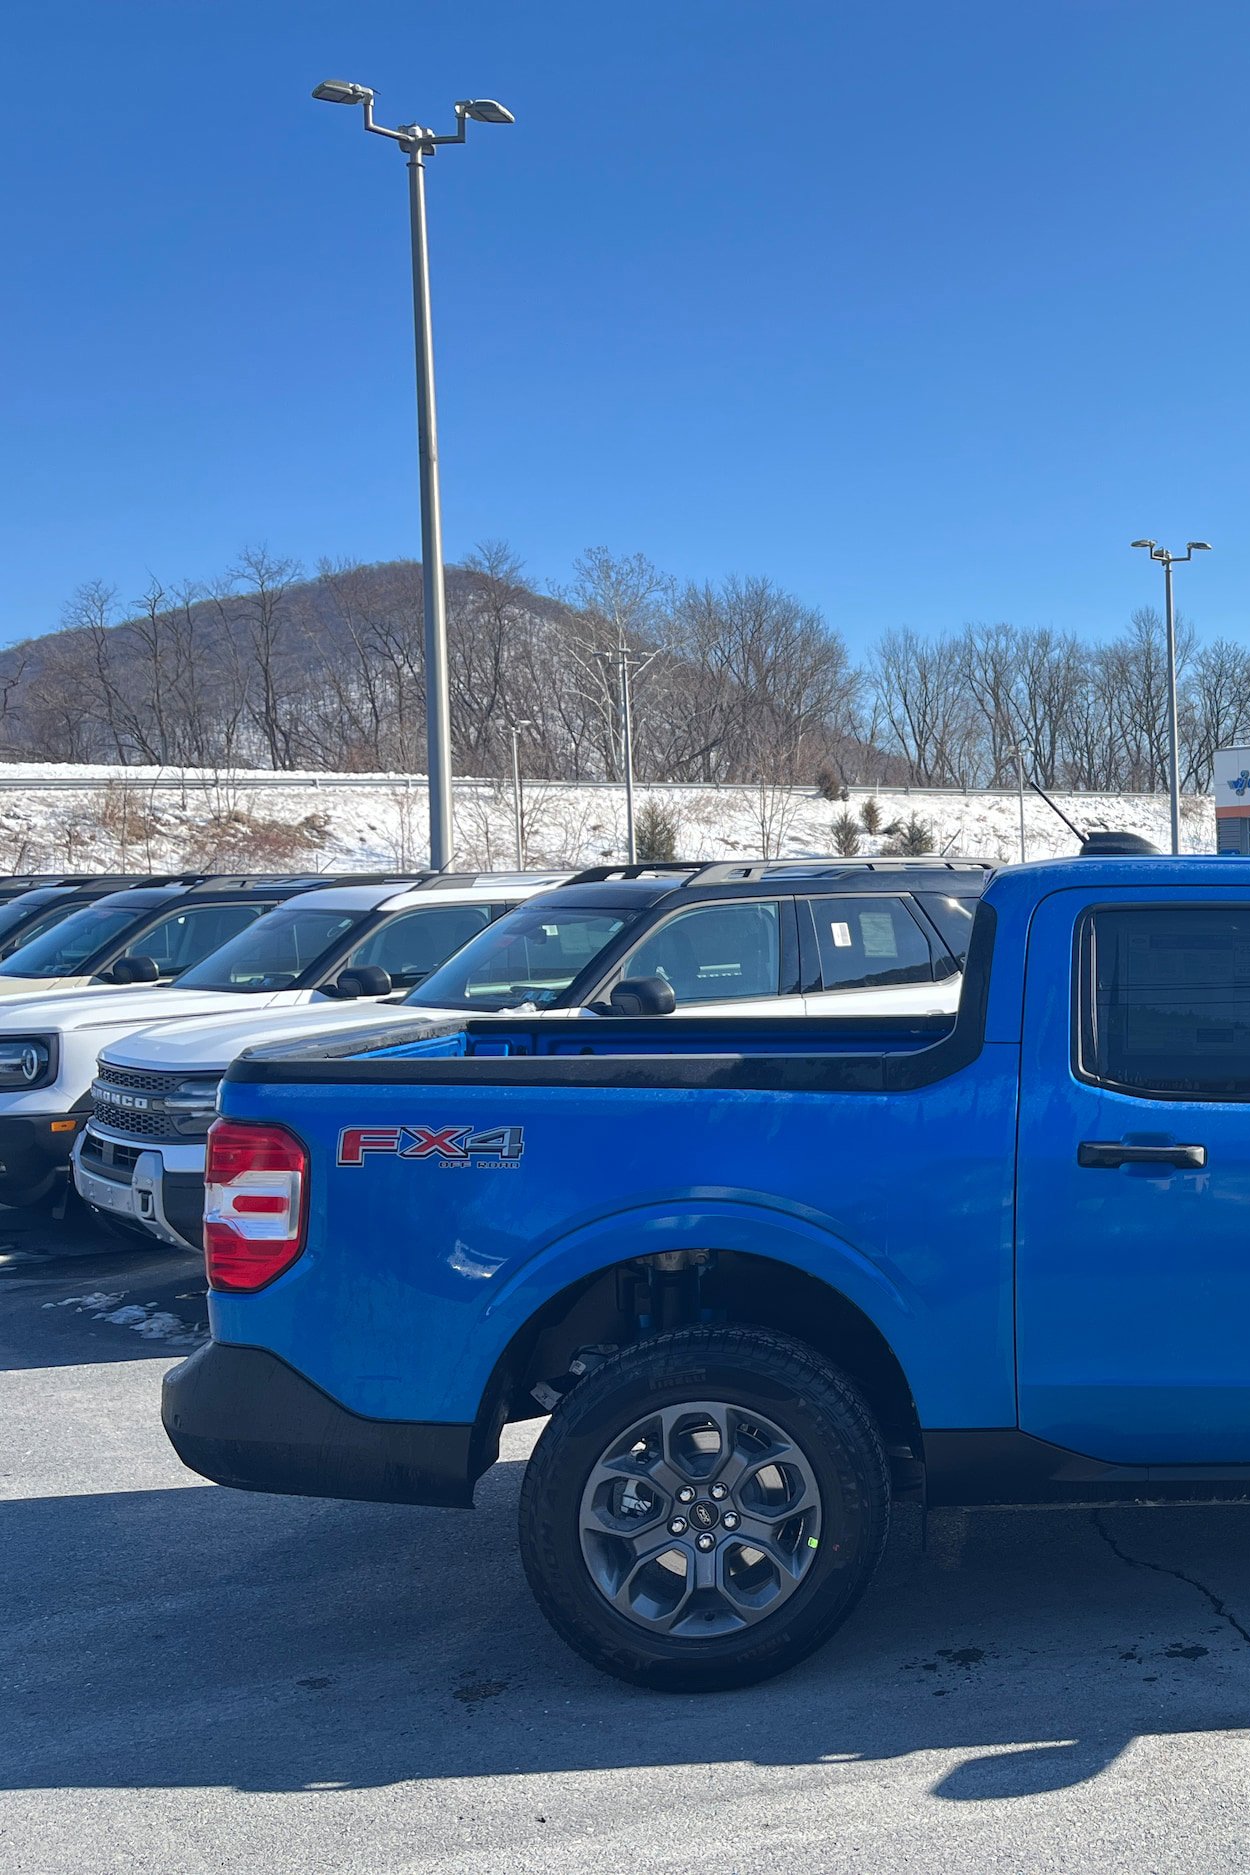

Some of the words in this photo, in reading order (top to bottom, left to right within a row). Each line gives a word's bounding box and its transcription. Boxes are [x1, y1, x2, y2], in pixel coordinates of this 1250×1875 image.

[91, 1084, 148, 1109] BRONCO
[337, 1125, 524, 1167] FX4
[439, 1160, 472, 1169] OFF
[477, 1160, 520, 1169] ROAD
